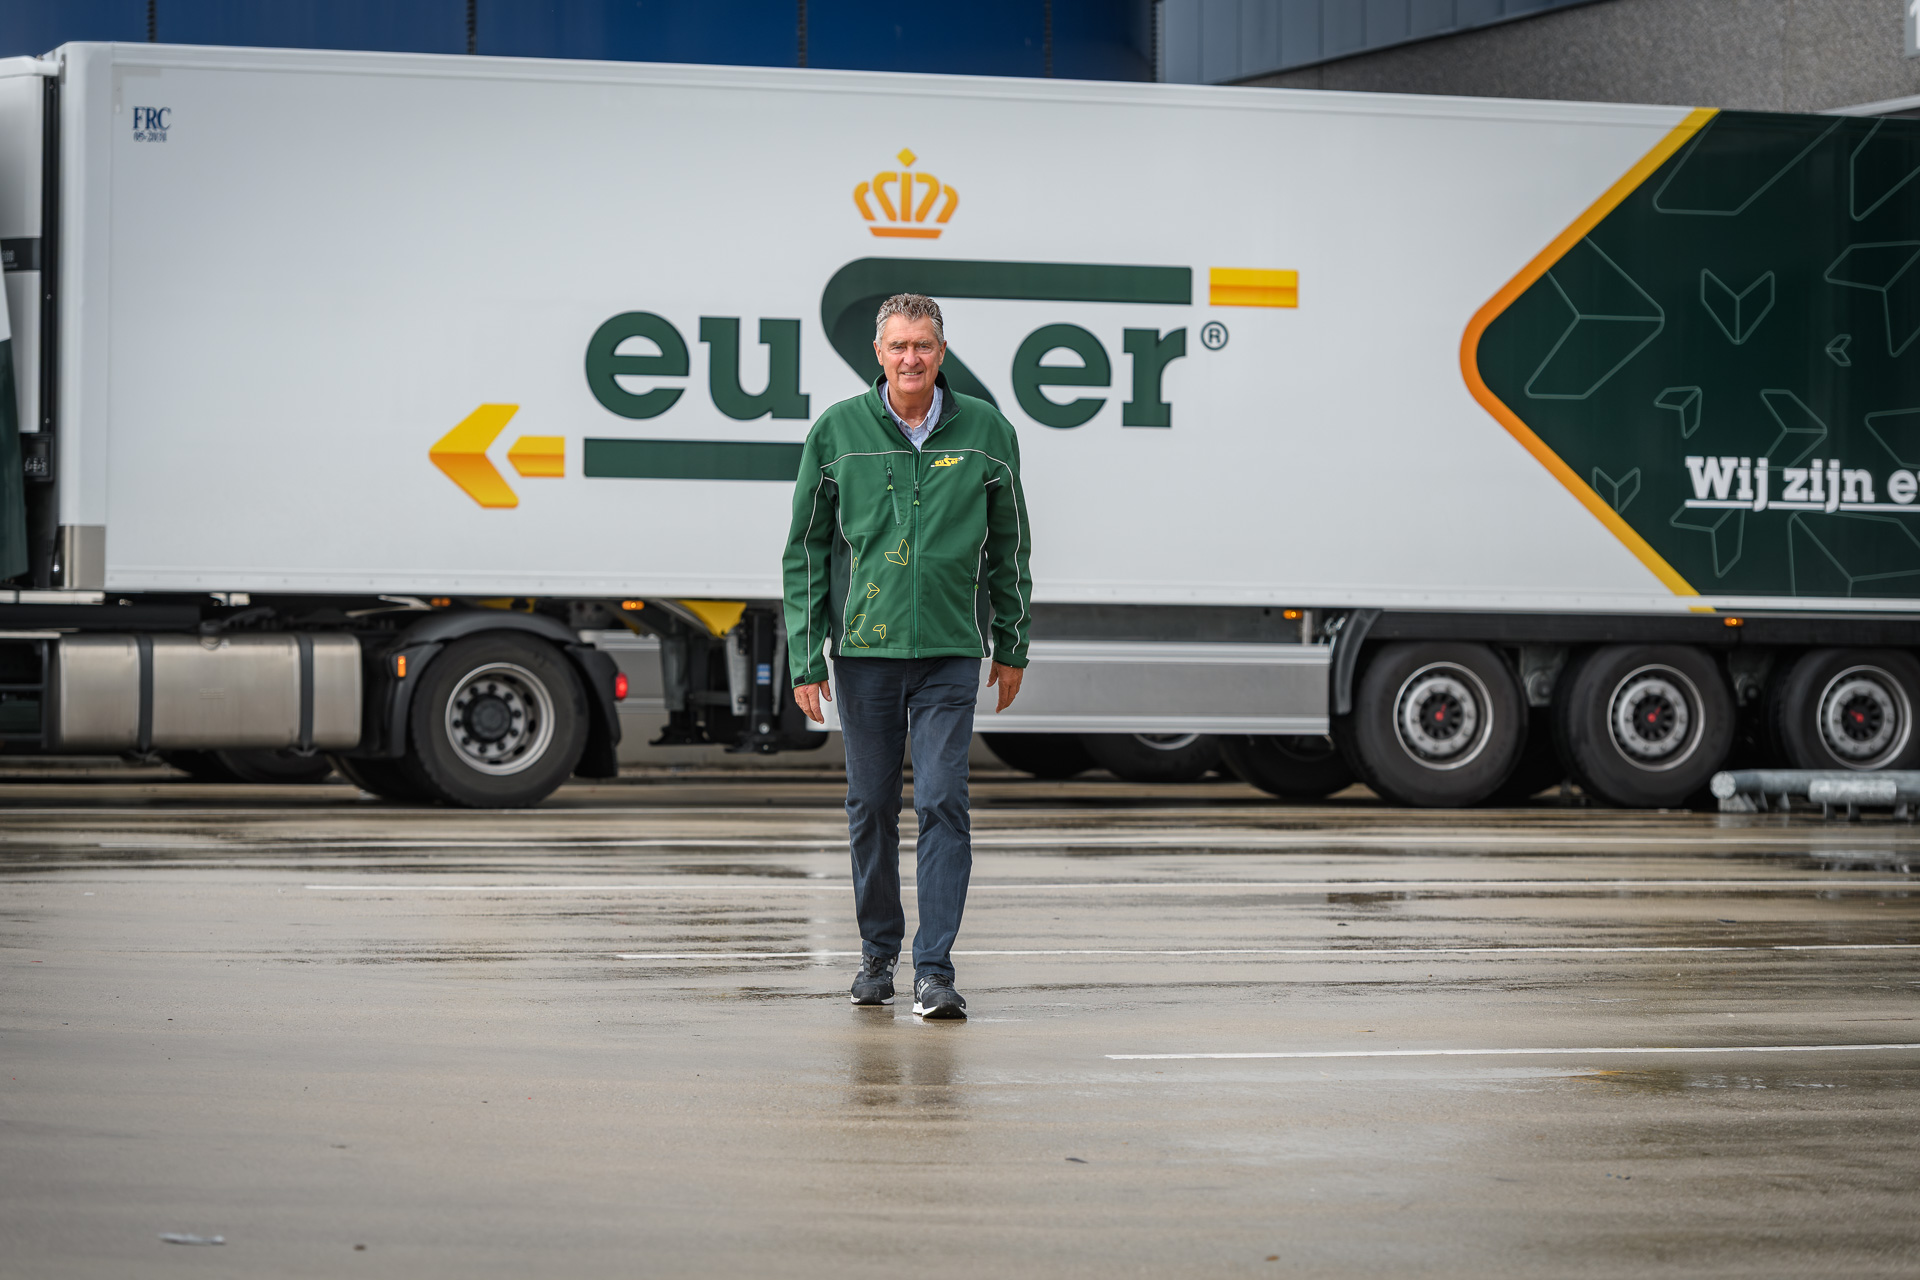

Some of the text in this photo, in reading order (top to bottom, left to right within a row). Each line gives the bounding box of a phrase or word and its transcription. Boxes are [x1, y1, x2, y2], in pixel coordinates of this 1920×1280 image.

[133, 106, 171, 130] FRC
[1685, 456, 1920, 513] Wij zijn e
